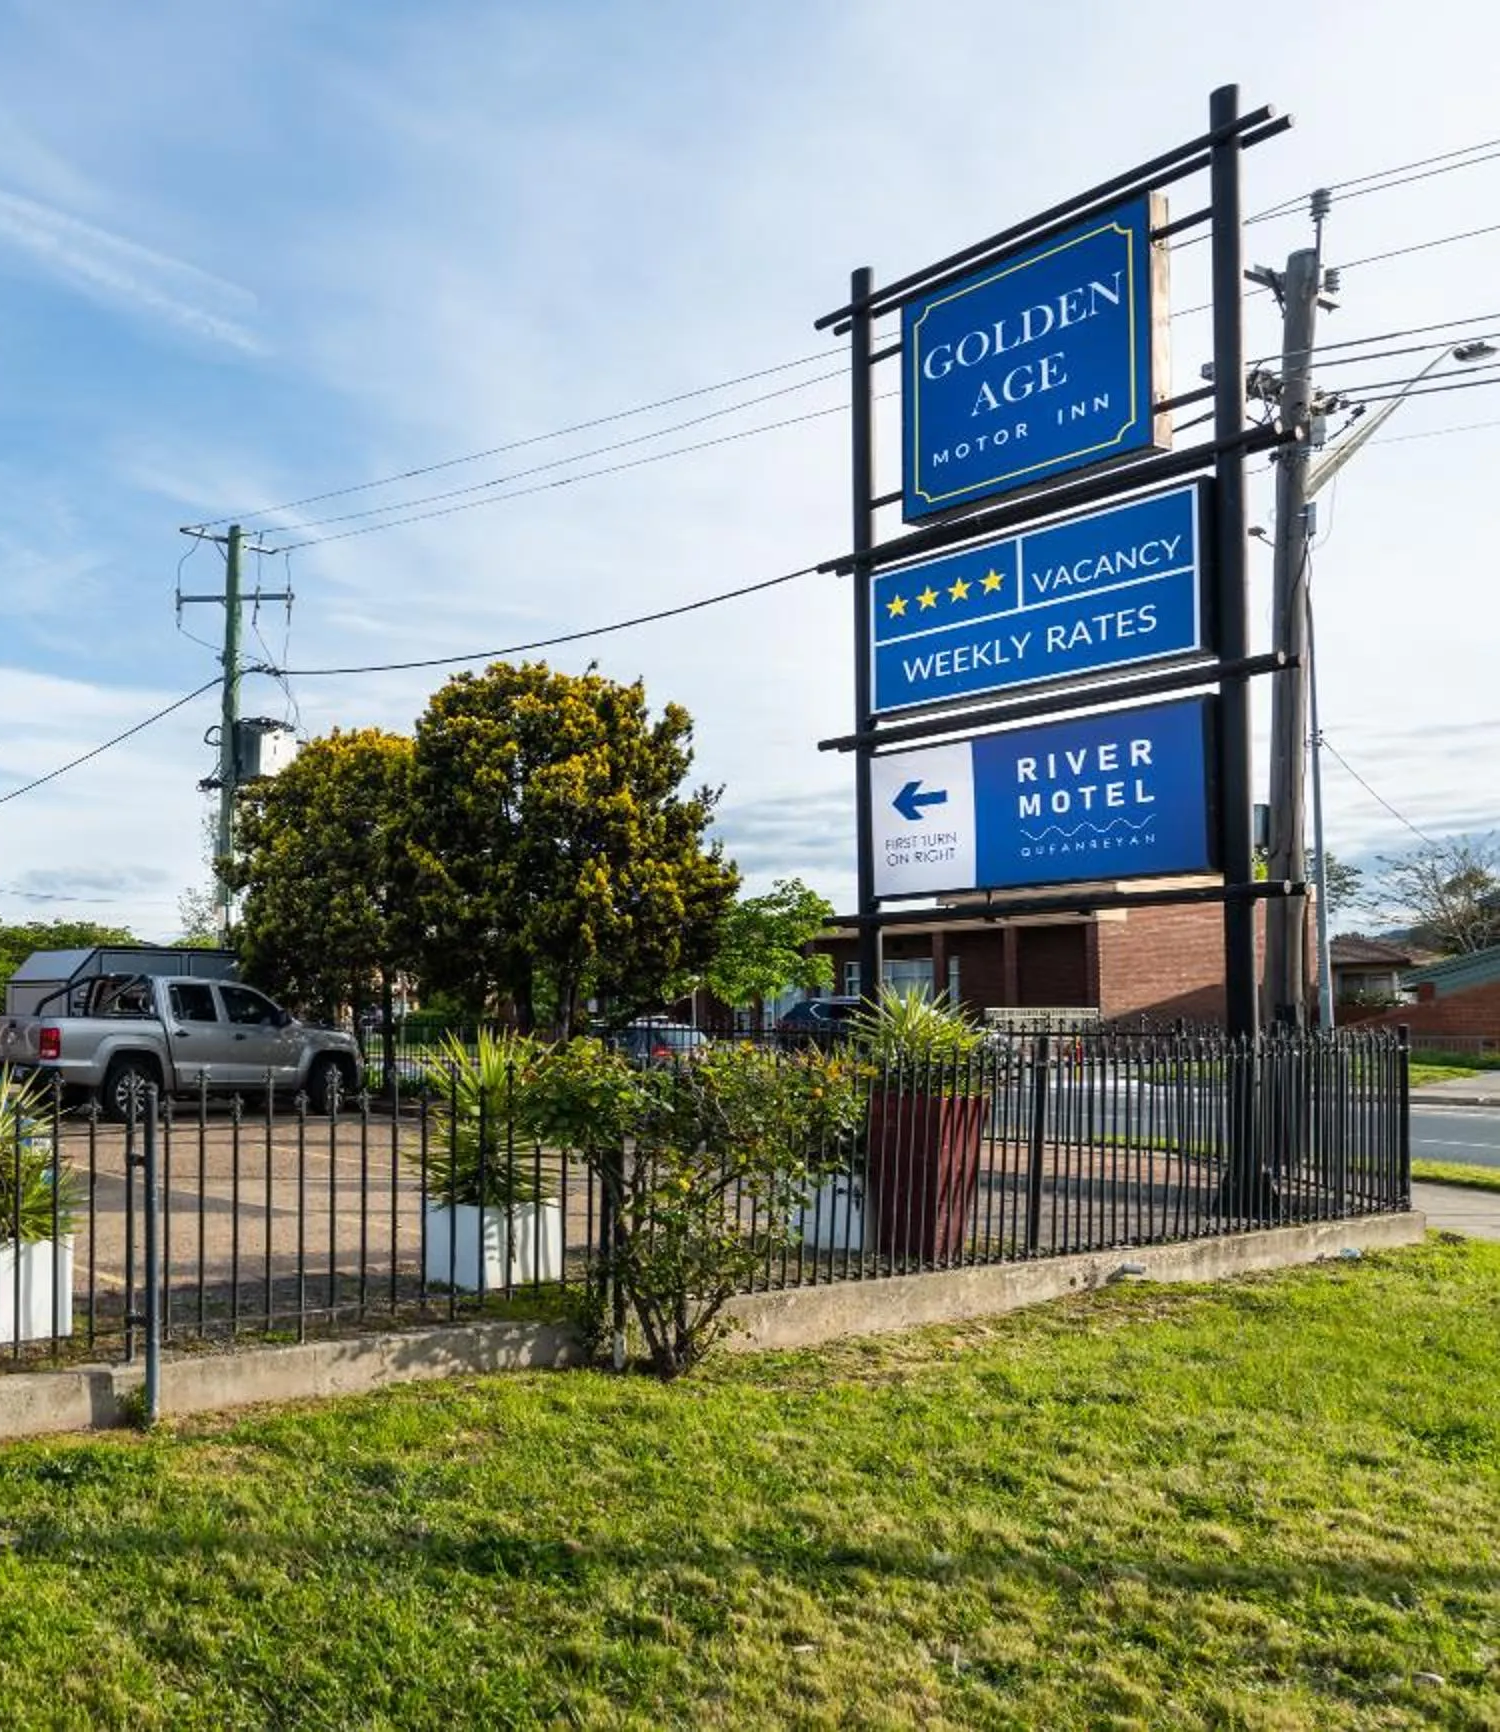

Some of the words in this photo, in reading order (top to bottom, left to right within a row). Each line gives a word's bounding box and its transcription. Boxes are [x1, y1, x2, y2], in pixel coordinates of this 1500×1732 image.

[923, 270, 1124, 379] GOLDEN
[971, 352, 1067, 416] AGE
[933, 423, 1029, 467] MOTOR
[1056, 393, 1110, 425] INN
[1032, 535, 1182, 593] VACANCY
[903, 632, 1032, 683] WEEKLY
[1046, 604, 1158, 654] RATES
[1016, 738, 1153, 783] RIVER
[1018, 779, 1156, 819] MOTEL
[885, 836, 917, 850] FIRST
[921, 831, 957, 847] TURN
[886, 853, 909, 867] ON
[915, 847, 955, 863] RIGHT
